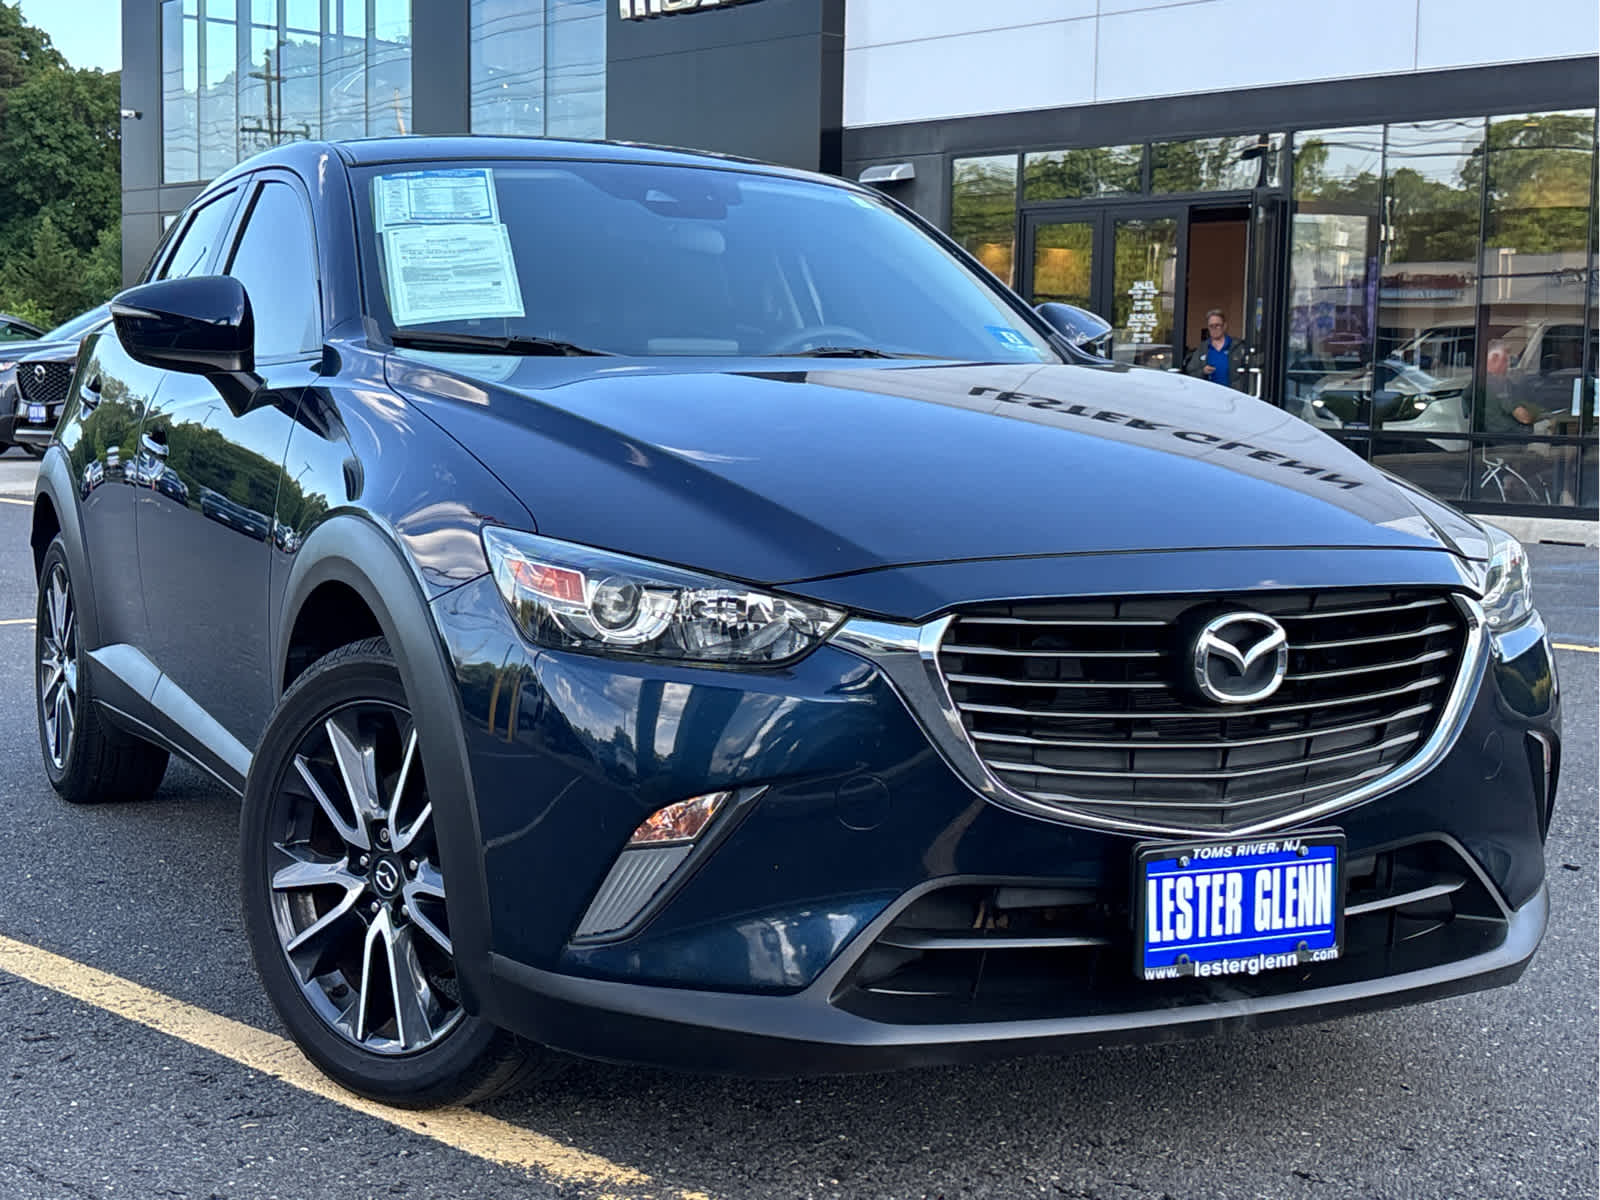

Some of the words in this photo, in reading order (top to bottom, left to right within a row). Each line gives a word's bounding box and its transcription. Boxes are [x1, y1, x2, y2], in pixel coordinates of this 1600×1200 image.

[1193, 846, 1233, 860] TOMS
[1236, 843, 1279, 857] RIVER,
[1283, 840, 1300, 851] NJ
[1148, 872, 1243, 943] LESTER
[1254, 863, 1332, 932] GLENN
[1144, 967, 1180, 980] www.
[1194, 953, 1298, 977] lesterglenn
[1310, 948, 1338, 962] .com
